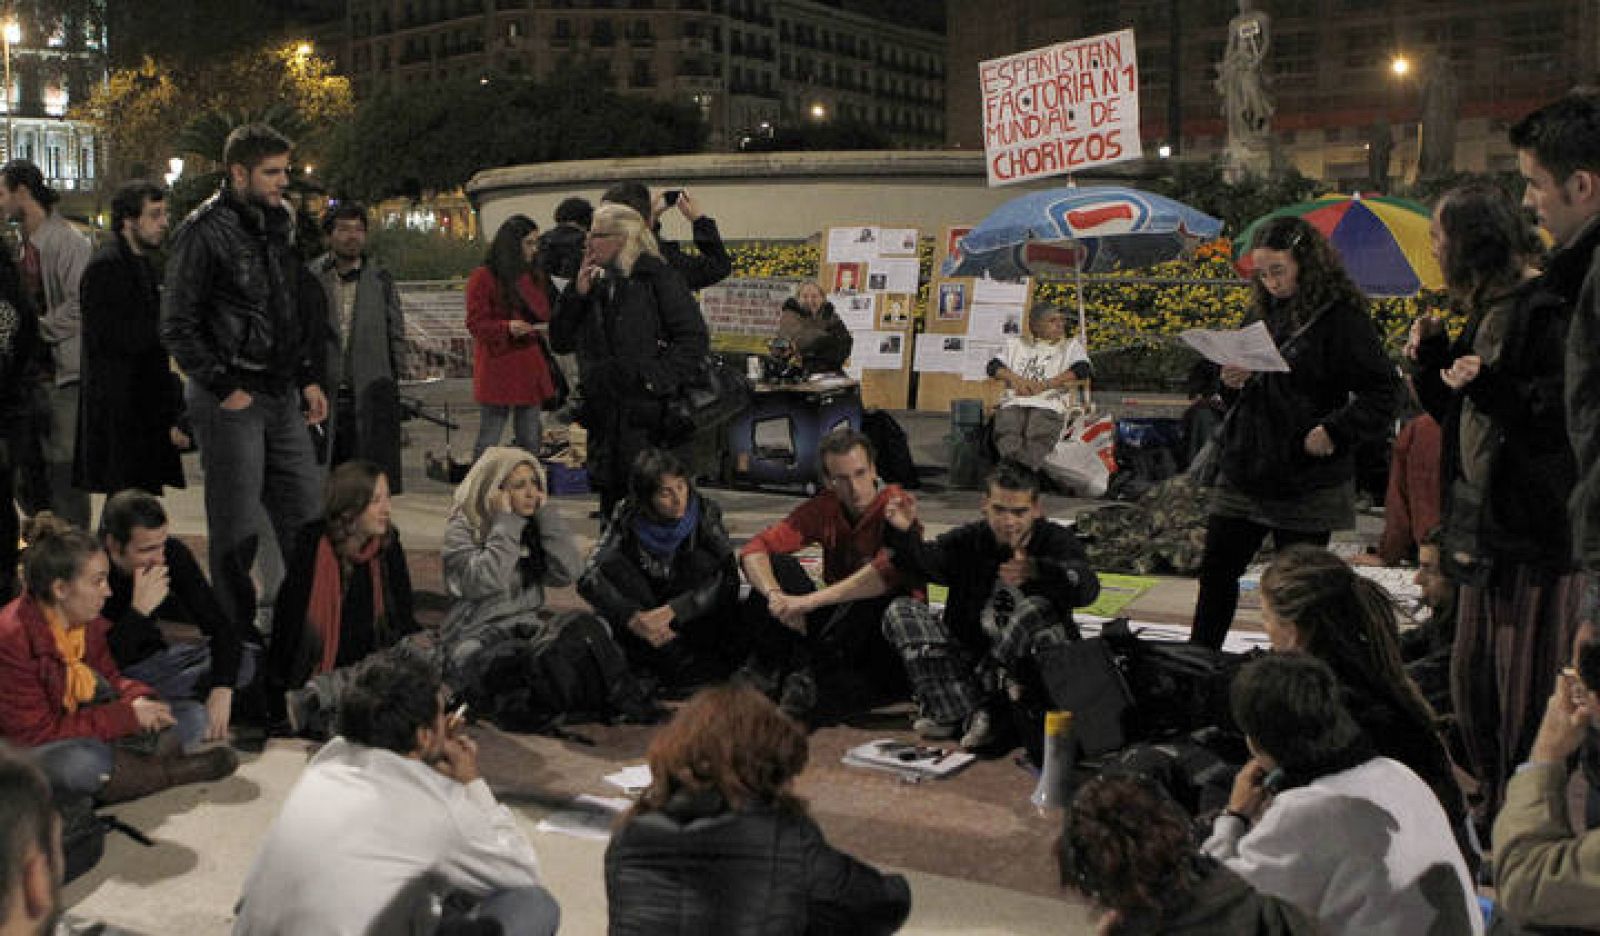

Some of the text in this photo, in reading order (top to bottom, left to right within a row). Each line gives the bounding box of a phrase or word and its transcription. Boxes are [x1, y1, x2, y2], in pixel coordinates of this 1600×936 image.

[981, 36, 1121, 94] ESPANISTAN
[986, 72, 1097, 122] FACTORIA
[986, 97, 1121, 145] MUNDIAL DE
[992, 129, 1122, 178] CHORIZOS
